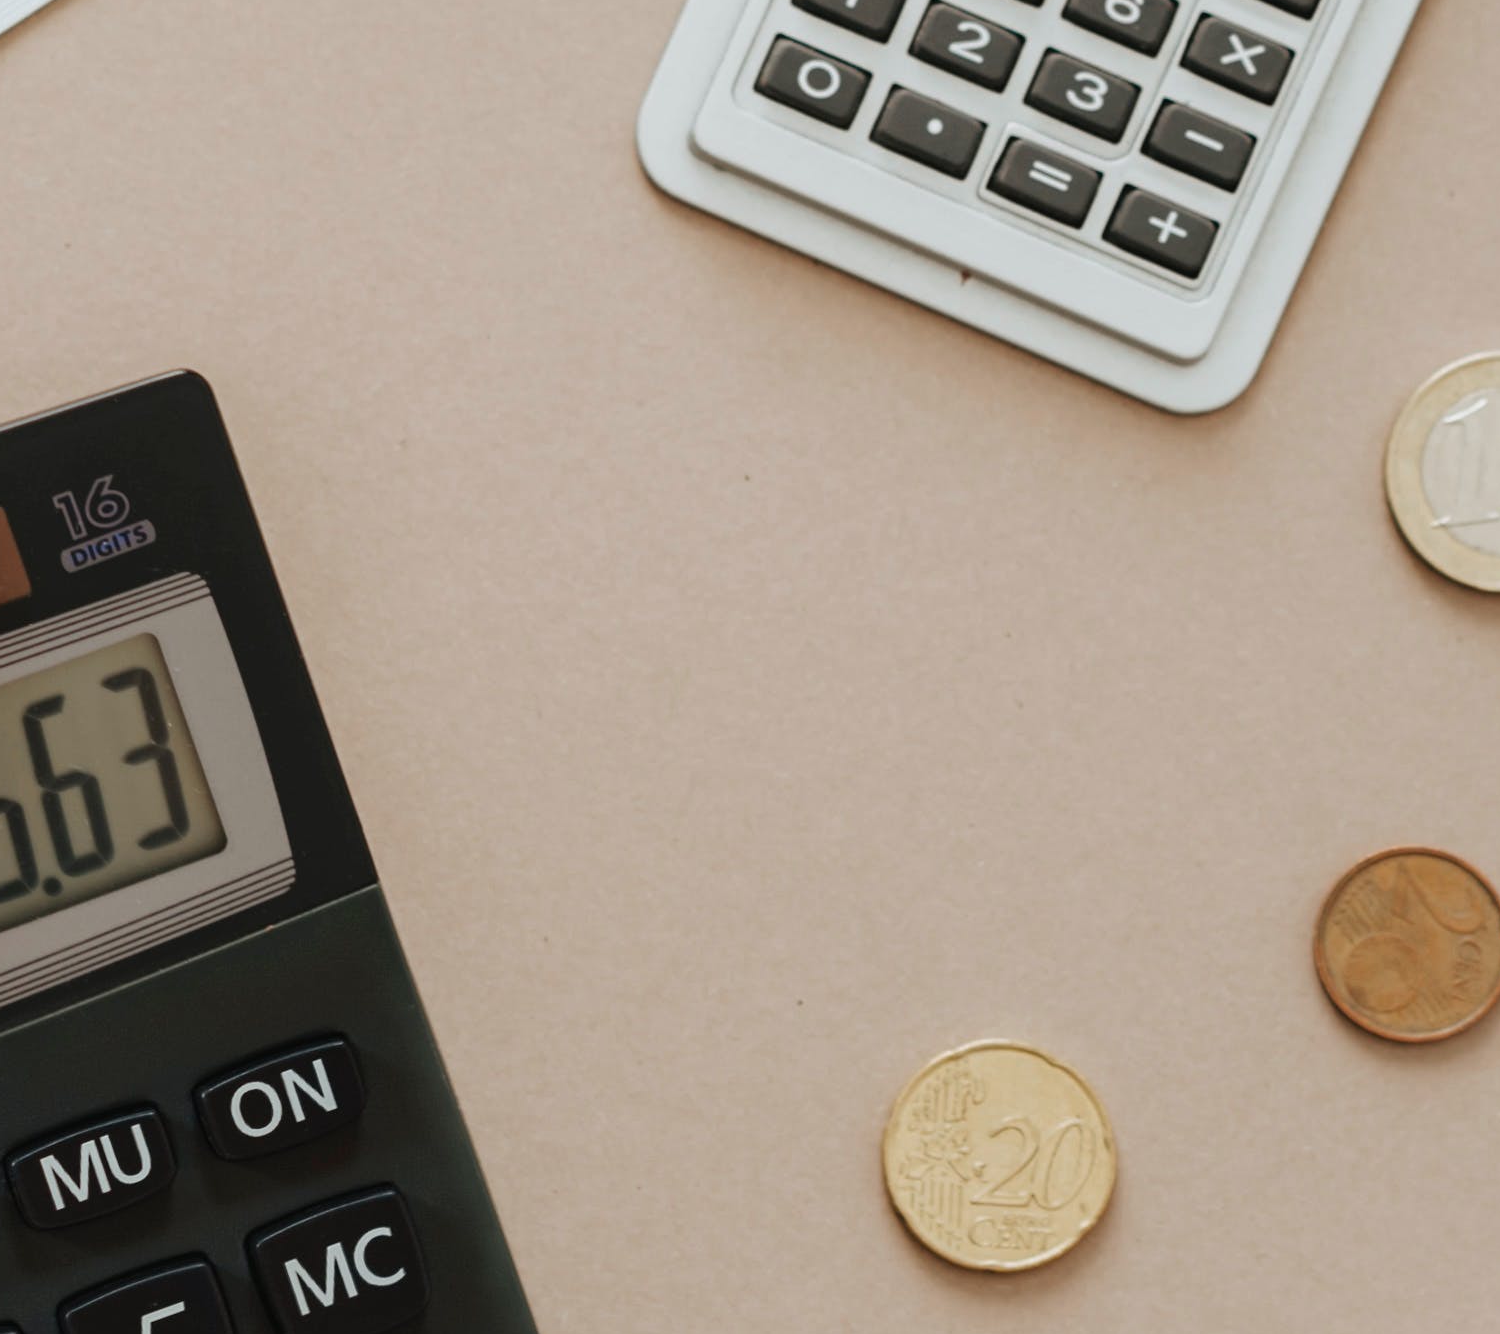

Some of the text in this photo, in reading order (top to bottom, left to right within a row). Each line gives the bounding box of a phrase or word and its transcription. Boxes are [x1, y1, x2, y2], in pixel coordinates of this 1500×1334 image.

[948, 21, 991, 64] 2
[1066, 71, 1106, 112] 3
[52, 473, 130, 540] 16
[70, 526, 148, 568] DIGITS
[230, 1058, 338, 1138] ON
[39, 1123, 152, 1211] MU
[970, 1116, 1097, 1212] 20
[966, 1217, 1053, 1250] CENT
[284, 1226, 406, 1316] MC
